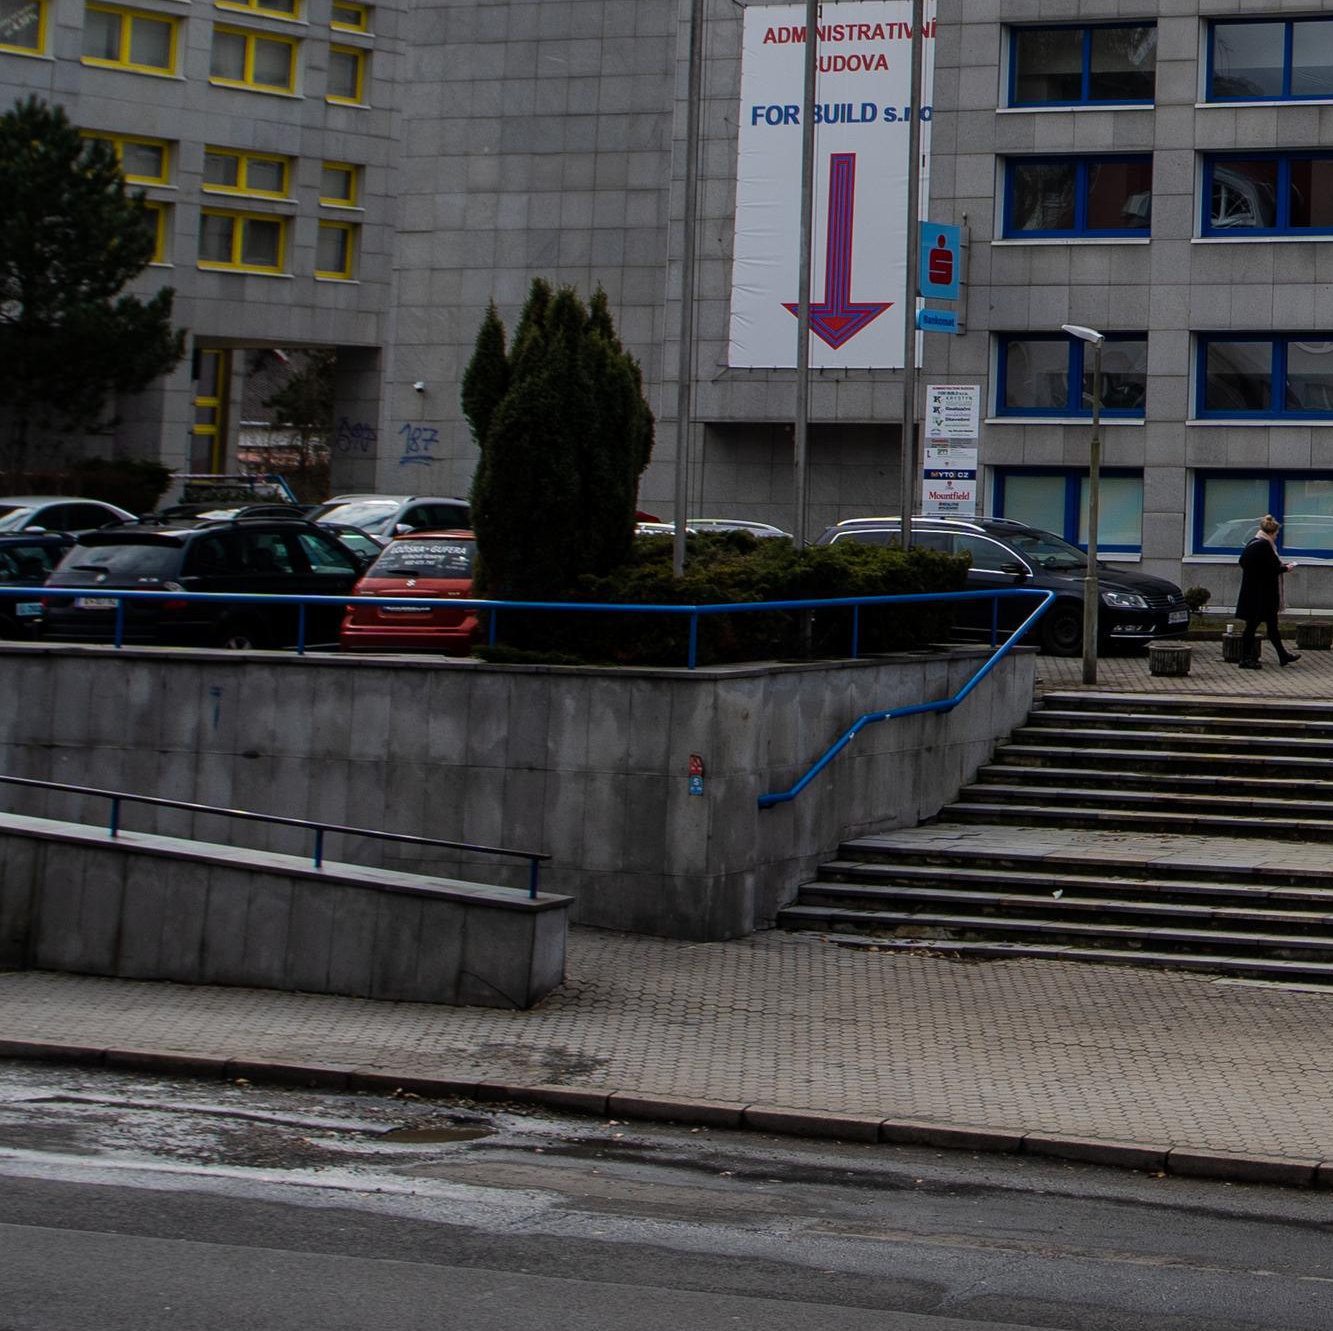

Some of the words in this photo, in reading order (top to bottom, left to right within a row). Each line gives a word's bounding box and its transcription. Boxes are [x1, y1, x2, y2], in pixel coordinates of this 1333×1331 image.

[762, 17, 937, 45] ADMNISTRATIVNÍ
[814, 53, 889, 73] UDOVA
[751, 104, 801, 127] FOR
[813, 102, 878, 125] BUILD
[883, 105, 934, 123] s.ro
[928, 491, 970, 501] Mountfield
